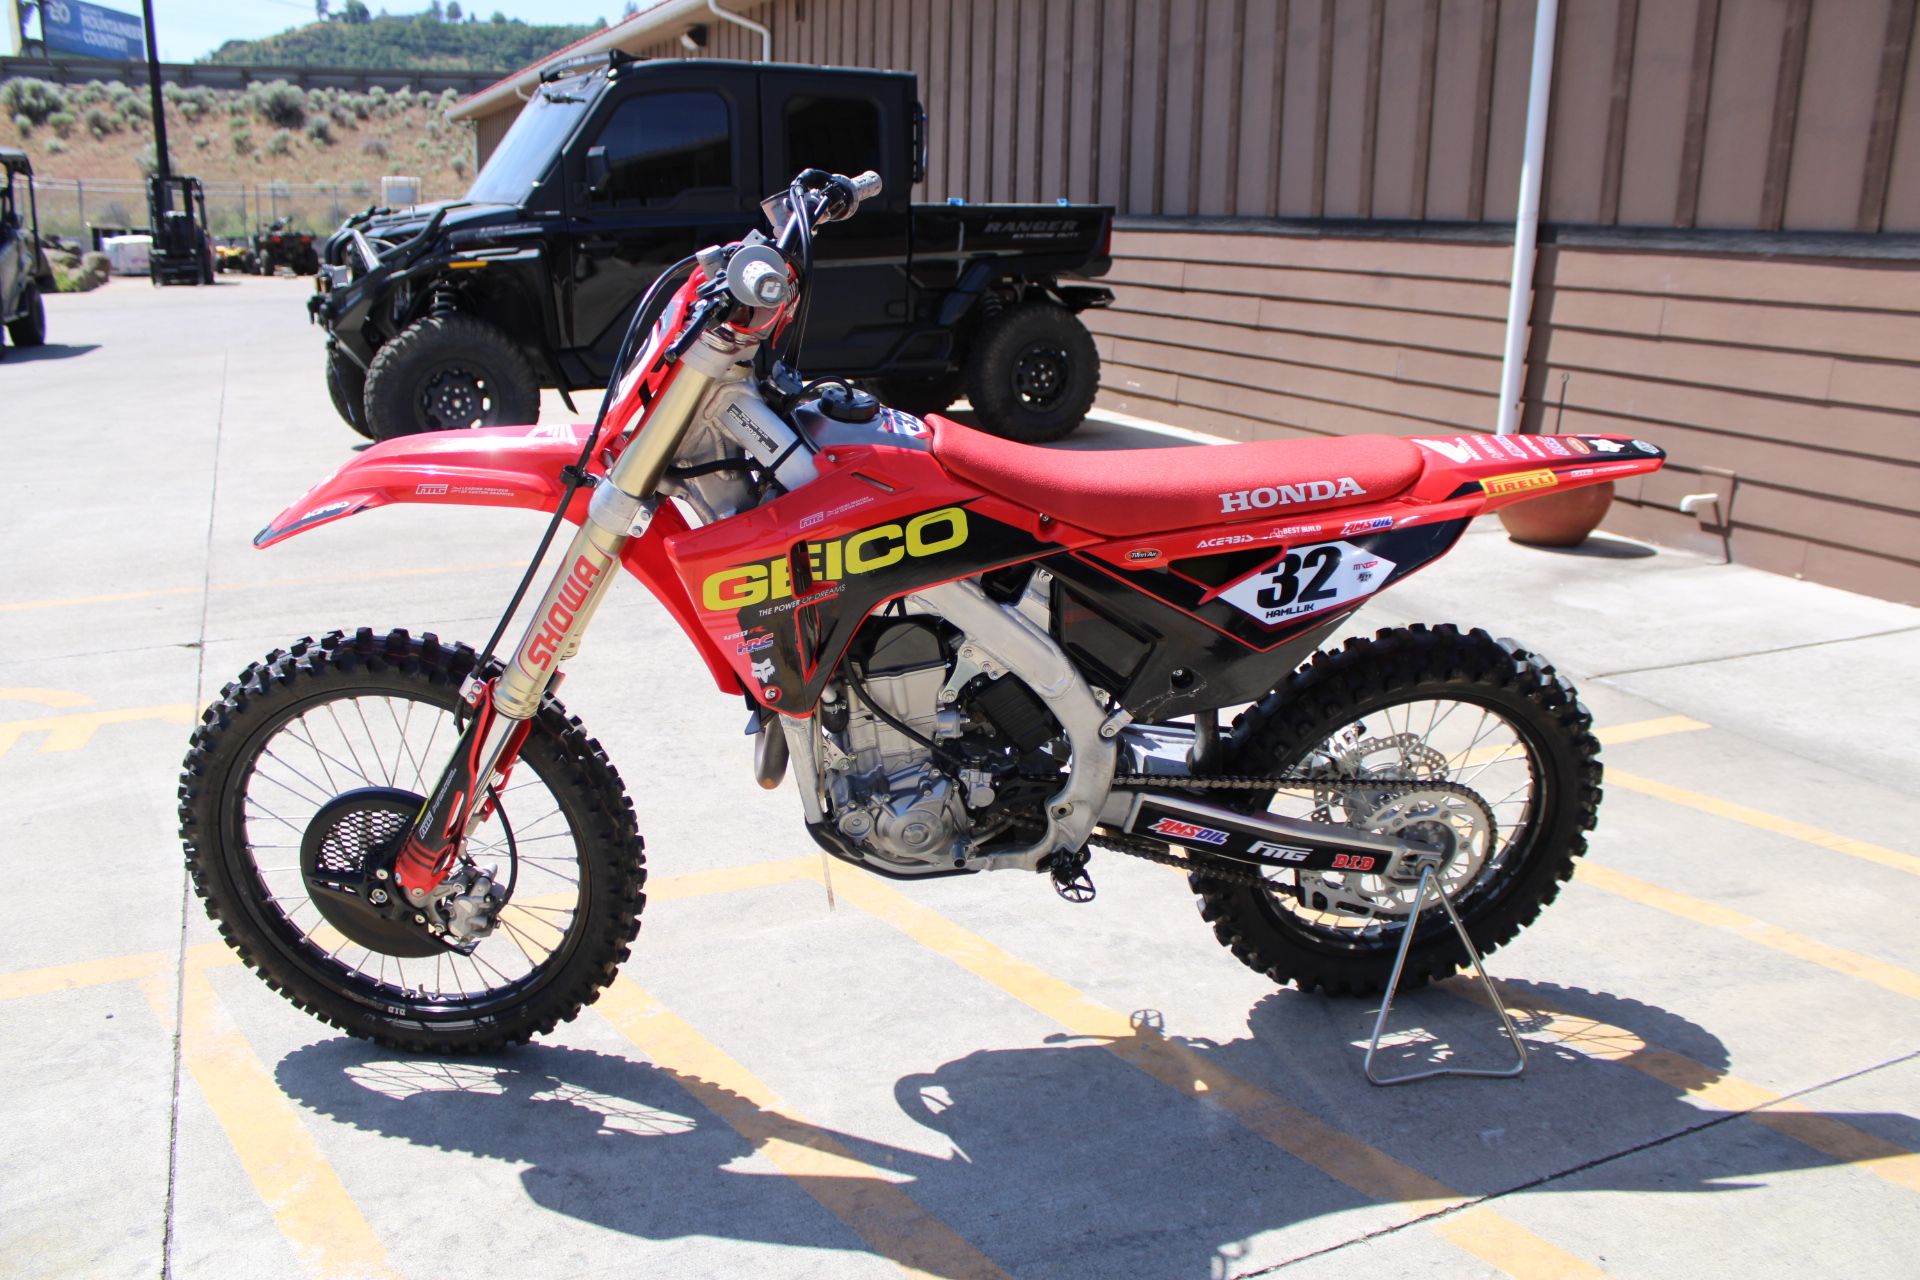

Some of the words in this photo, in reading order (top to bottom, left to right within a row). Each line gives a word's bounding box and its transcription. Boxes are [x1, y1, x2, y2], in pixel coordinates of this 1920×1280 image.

[984, 221, 1079, 232] RANGER
[1218, 477, 1366, 513] HONDA
[1486, 471, 1555, 494] PIRELLI
[1301, 525, 1322, 533] BUILD
[1341, 516, 1393, 535] AMSOIL
[702, 507, 969, 611] GEICO
[1256, 546, 1342, 609] 32
[527, 555, 601, 672] SHOWA
[758, 607, 772, 617] THE
[774, 599, 800, 614] POWER
[814, 583, 847, 600] DREAMS
[736, 632, 775, 655] HRC
[1148, 818, 1230, 845] AMSOIL
